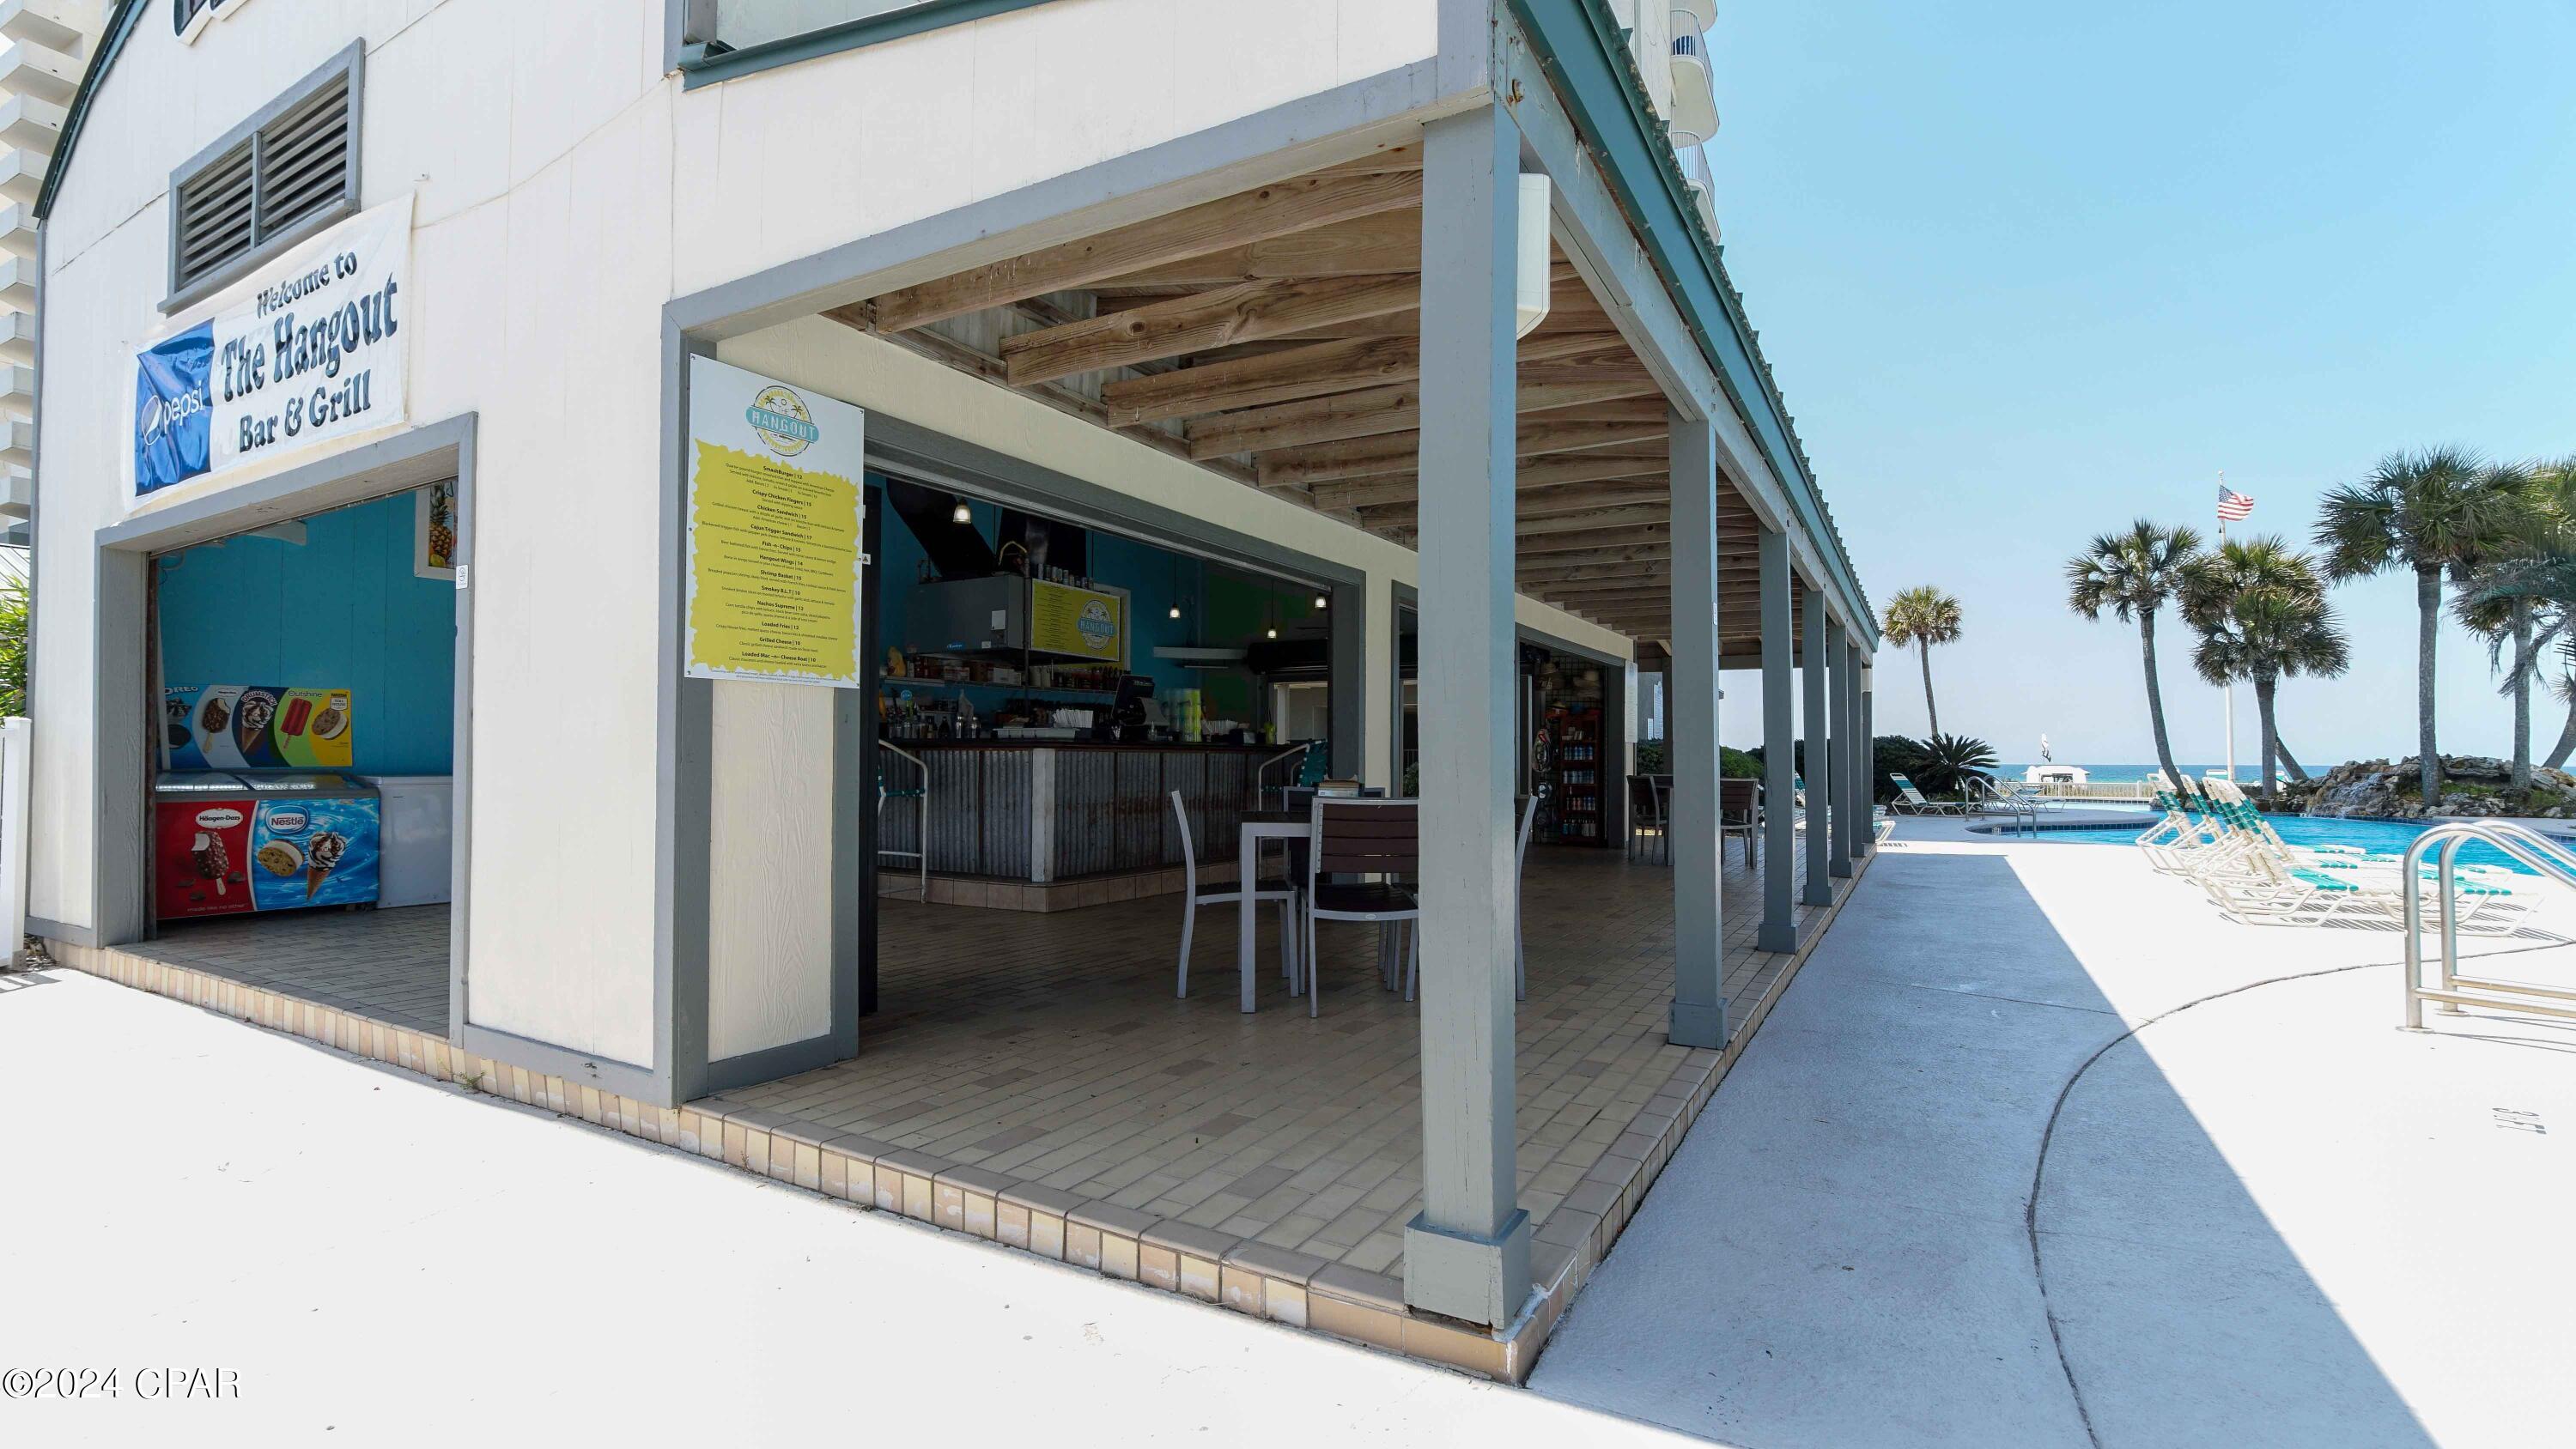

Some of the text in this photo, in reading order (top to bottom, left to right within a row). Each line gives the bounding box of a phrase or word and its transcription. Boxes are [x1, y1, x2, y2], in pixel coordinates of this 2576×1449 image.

[257, 252, 357, 318] Welcome to
[221, 272, 398, 403] The Hangout
[162, 381, 204, 427] pepsi
[240, 369, 371, 453] Bar & Grill
[751, 410, 815, 440] HANGOUT
[751, 488, 768, 498] Crispy
[767, 492, 786, 501] Chicken
[787, 496, 802, 506] Fingers
[756, 504, 775, 512] Chicken
[775, 507, 798, 518] Sandwich
[750, 523, 764, 532] Cajun
[763, 525, 781, 535] Trigger
[781, 529, 803, 538] Sandwich
[759, 554, 780, 563] Hangout
[780, 557, 794, 566] Wings
[760, 569, 777, 578] Shrimp
[761, 585, 780, 593] Smokey
[774, 602, 795, 610] Supreme
[165, 686, 198, 696] OREO
[240, 690, 277, 706] DRUMSTICK
